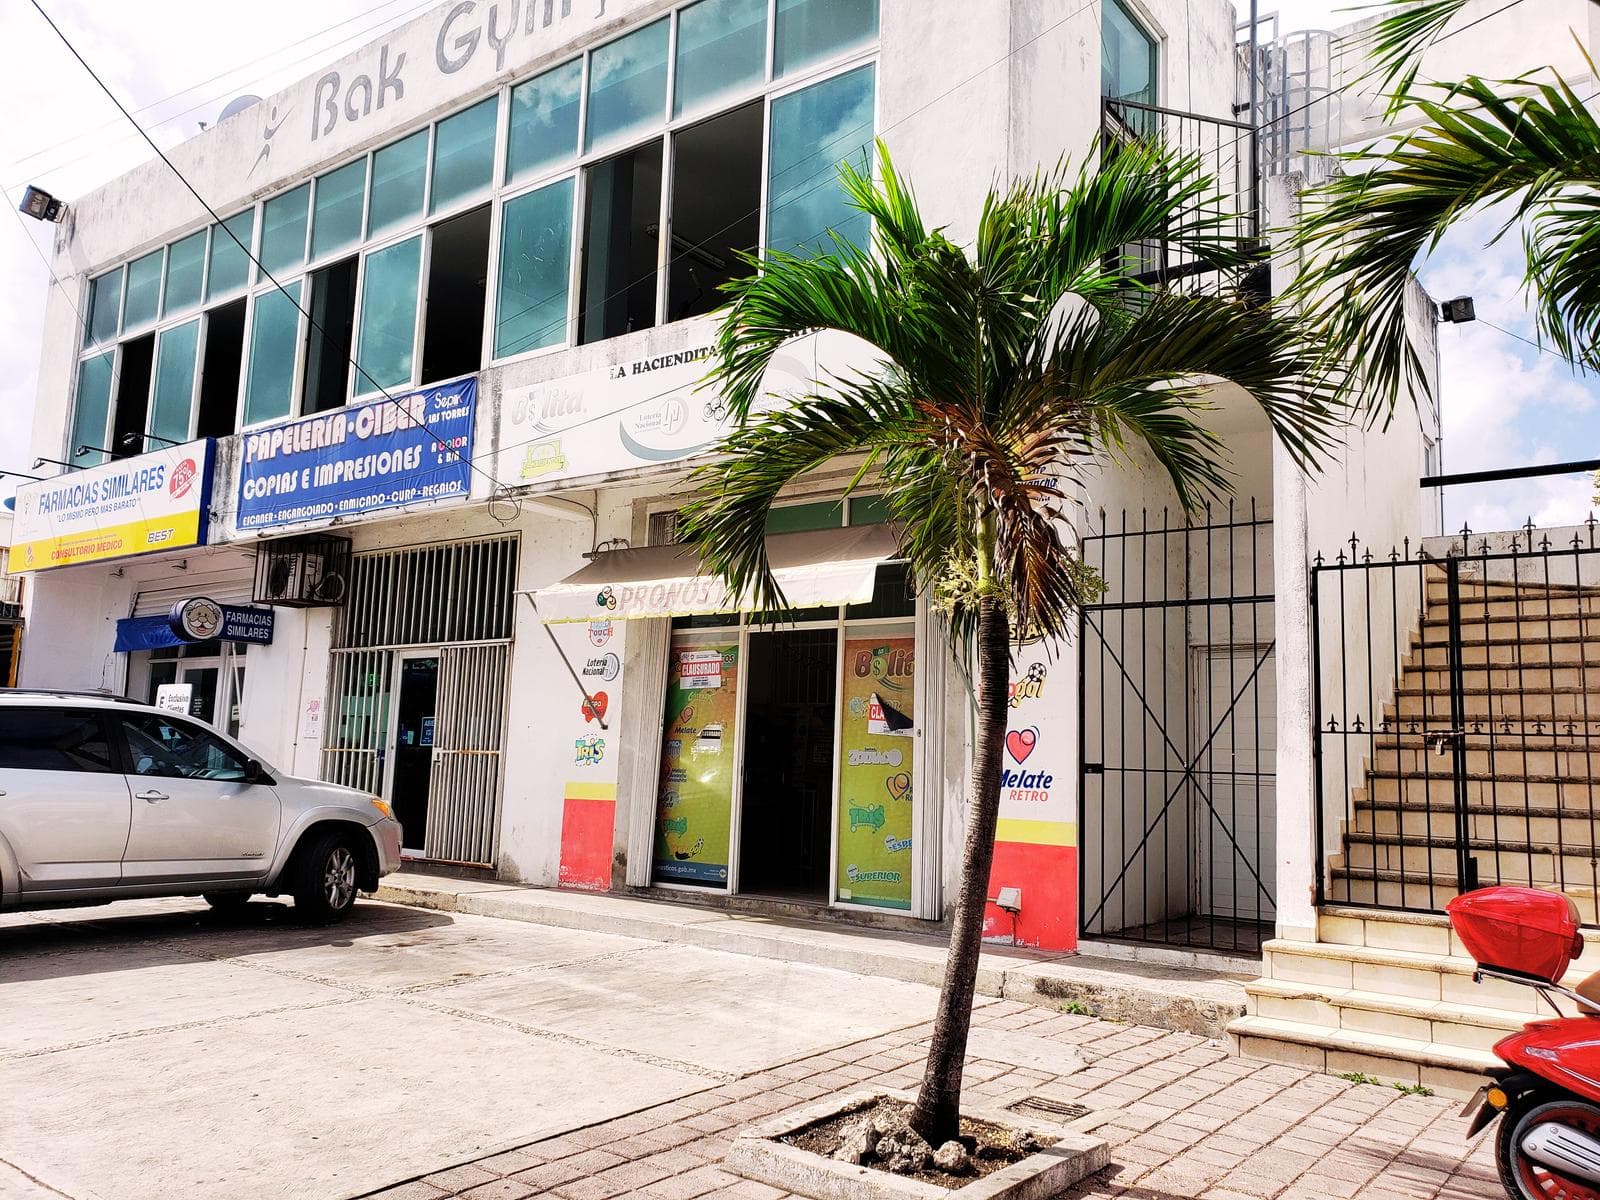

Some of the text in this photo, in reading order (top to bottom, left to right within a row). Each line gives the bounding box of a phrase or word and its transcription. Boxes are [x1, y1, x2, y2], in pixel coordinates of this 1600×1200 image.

[312, 44, 407, 141] Bak
[632, 346, 717, 374] HACIENDITA
[429, 406, 470, 424] LAS TORRES
[431, 436, 467, 453] A COLOR
[244, 445, 422, 500] COPIAS E IMPRESIONES
[39, 481, 98, 514] FARMACIAS
[102, 465, 164, 501] SIMILARES
[243, 508, 273, 526] ESCANER
[278, 502, 333, 521] ENGARGOLADO
[391, 485, 415, 503] CURP
[422, 480, 461, 498] REGALOS
[66, 508, 84, 521] MISMO
[85, 504, 99, 517] PERO
[148, 529, 174, 543] BEST
[51, 546, 95, 560] CONSULTORIO
[97, 540, 122, 553] MEDICO
[226, 611, 272, 626] FARMACIAS
[227, 625, 269, 639] SIMILARES
[588, 627, 613, 638] TOUCH
[682, 662, 720, 676] CLAUSURADO
[576, 739, 605, 764] TRIS
[1009, 790, 1048, 802] RETRO
[855, 872, 901, 882] SUPERIOR
